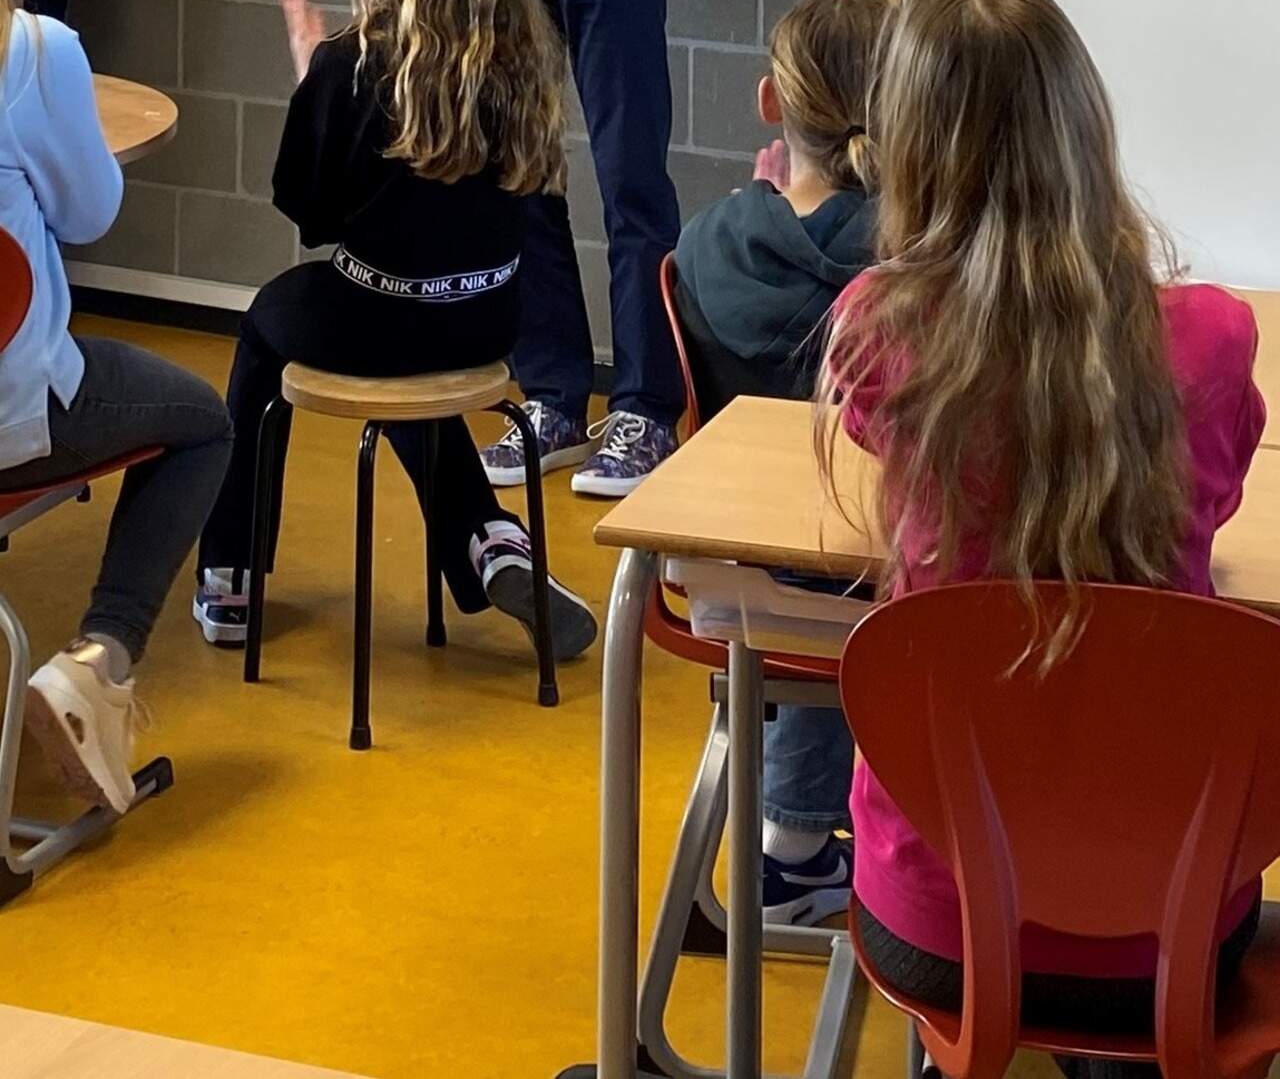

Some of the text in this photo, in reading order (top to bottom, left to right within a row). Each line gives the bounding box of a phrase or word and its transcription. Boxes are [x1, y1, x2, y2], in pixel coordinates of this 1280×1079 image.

[347, 260, 373, 285] NIK
[380, 276, 413, 294] NIK
[421, 278, 452, 294] NIK
[460, 273, 488, 291] NIK
